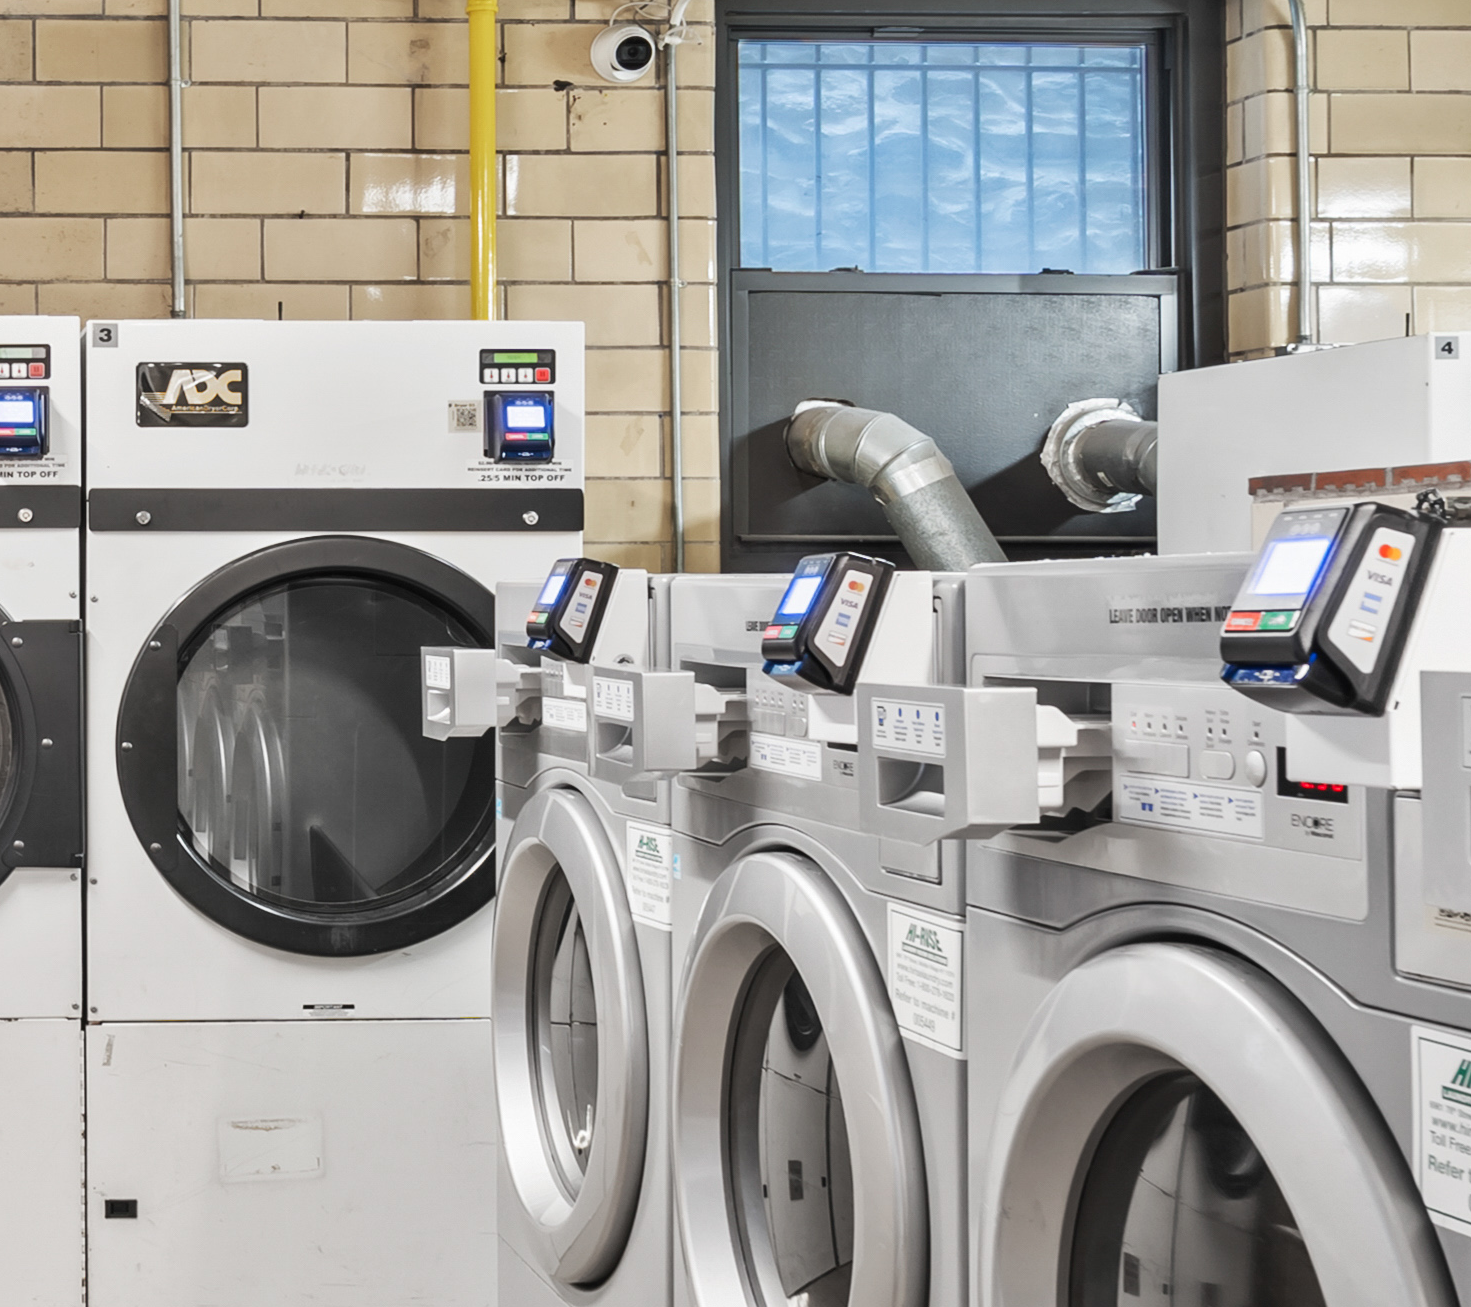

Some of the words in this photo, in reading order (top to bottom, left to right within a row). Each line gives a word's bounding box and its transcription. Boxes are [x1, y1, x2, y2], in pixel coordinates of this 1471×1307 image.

[98, 328, 113, 343] 3
[1440, 341, 1454, 355] 4
[162, 369, 243, 405] ADC
[1366, 569, 1393, 587] VISA
[840, 597, 859, 610] VISA
[1108, 608, 1134, 624] LEAVE
[1135, 608, 1159, 624] DOOR
[1160, 607, 1184, 623] OPEN
[1186, 606, 1211, 623] WHEN
[1290, 813, 1335, 833] ENCORE
[1429, 1130, 1448, 1148] Toll
[1428, 1154, 1465, 1181] Refer
